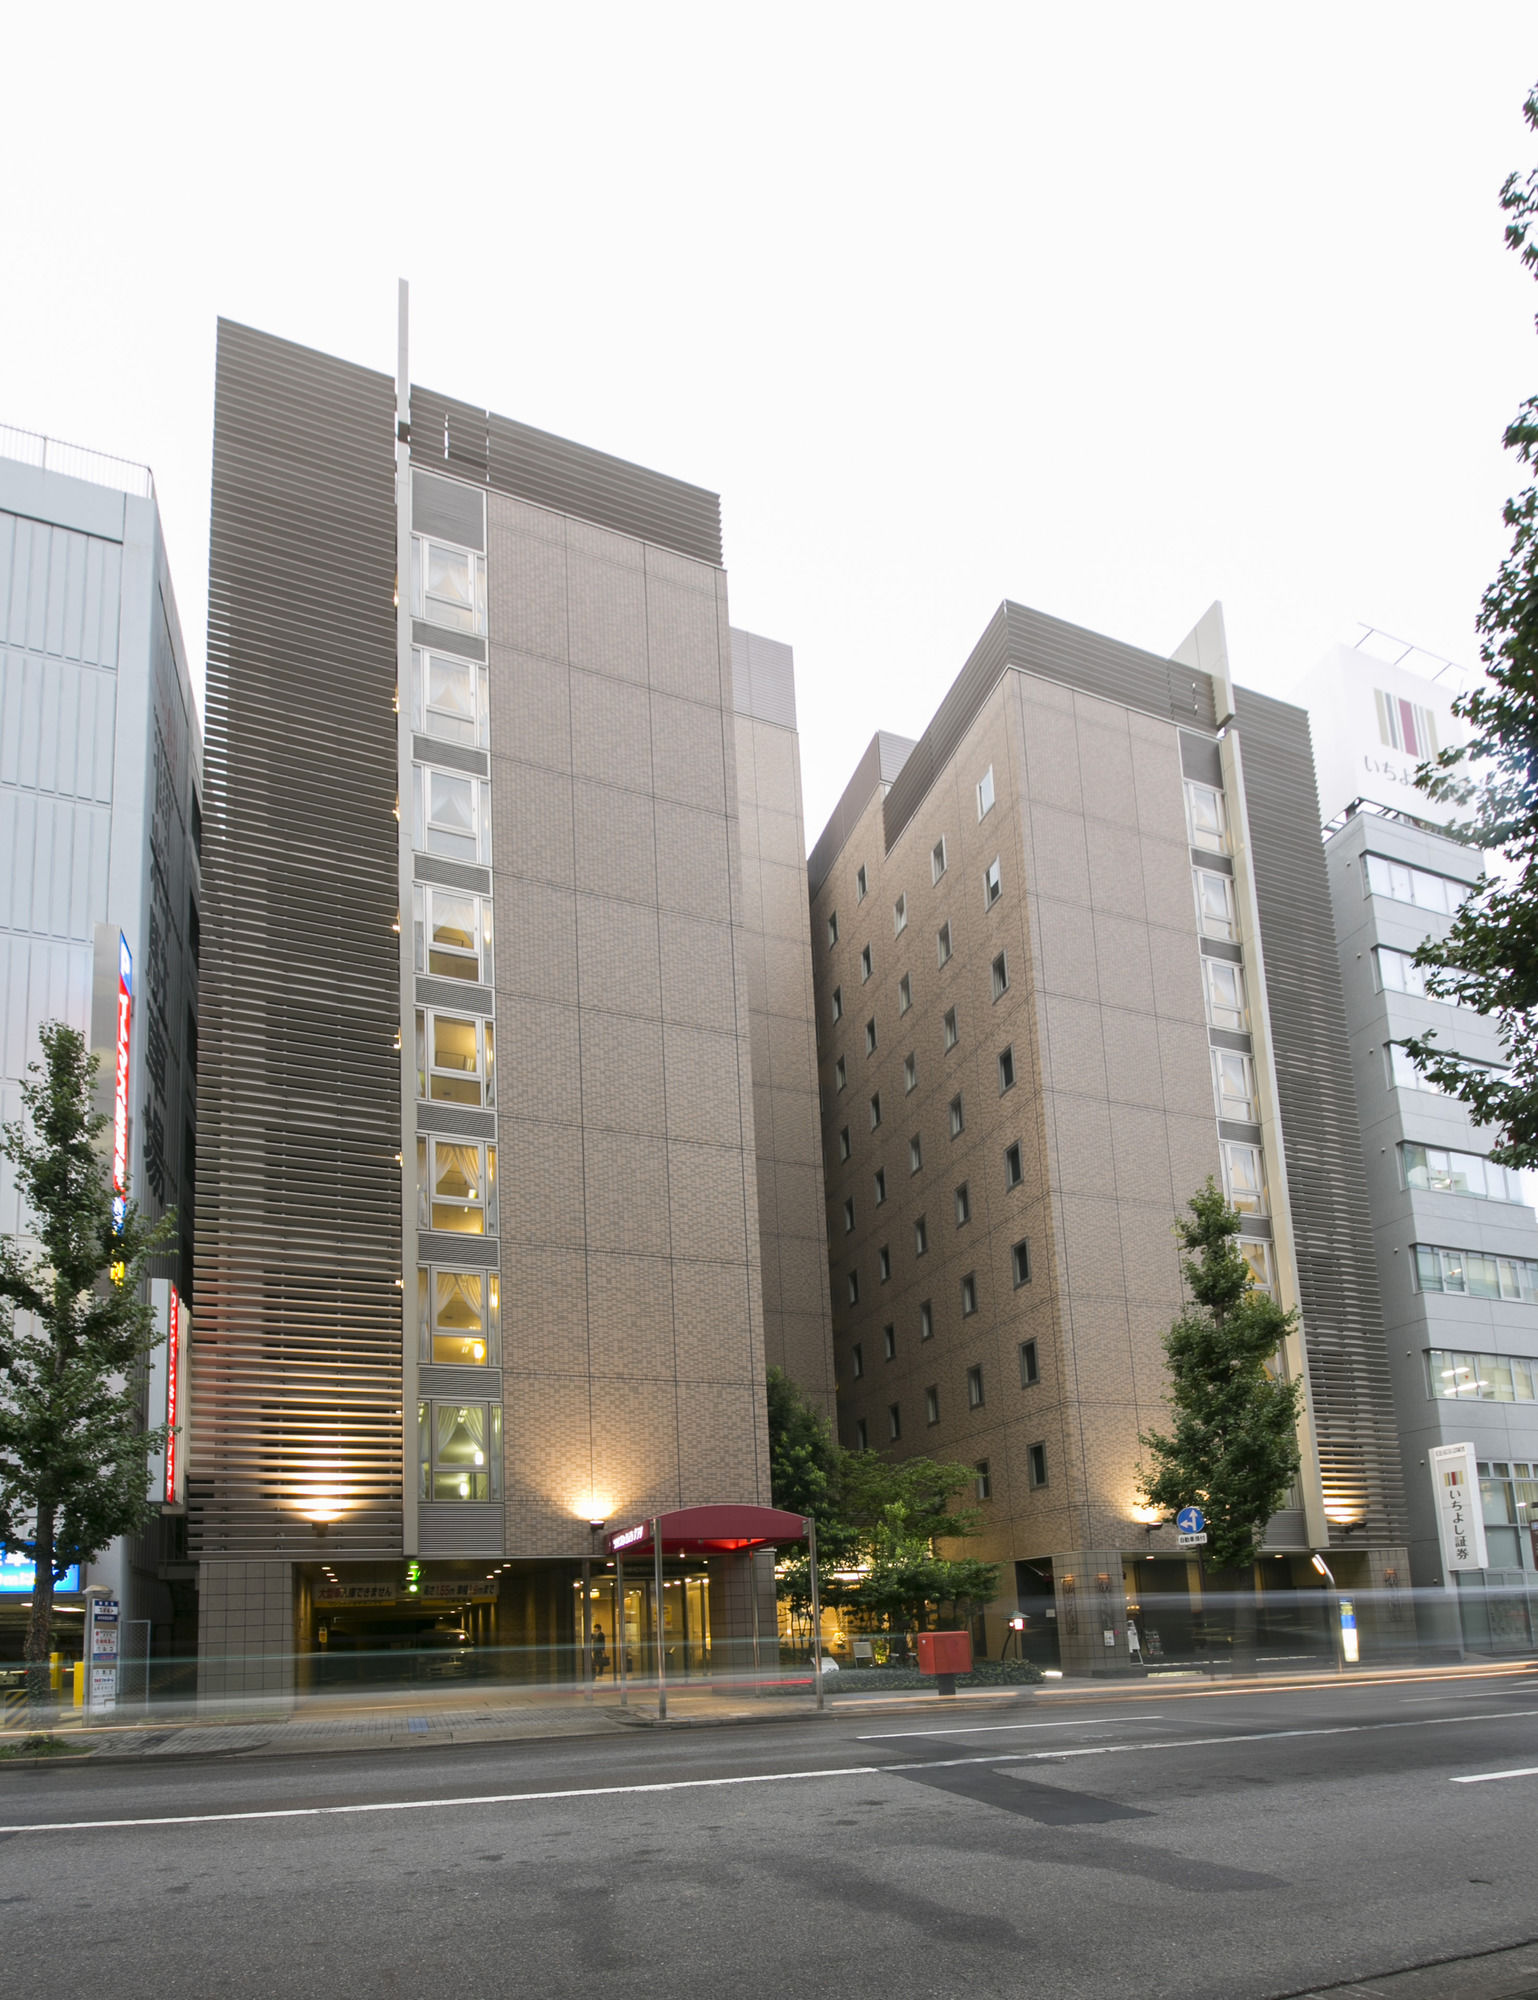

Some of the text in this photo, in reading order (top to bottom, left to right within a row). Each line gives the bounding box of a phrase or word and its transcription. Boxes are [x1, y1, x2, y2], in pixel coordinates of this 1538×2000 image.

[1449, 1489, 1468, 1560] いちよし証券
